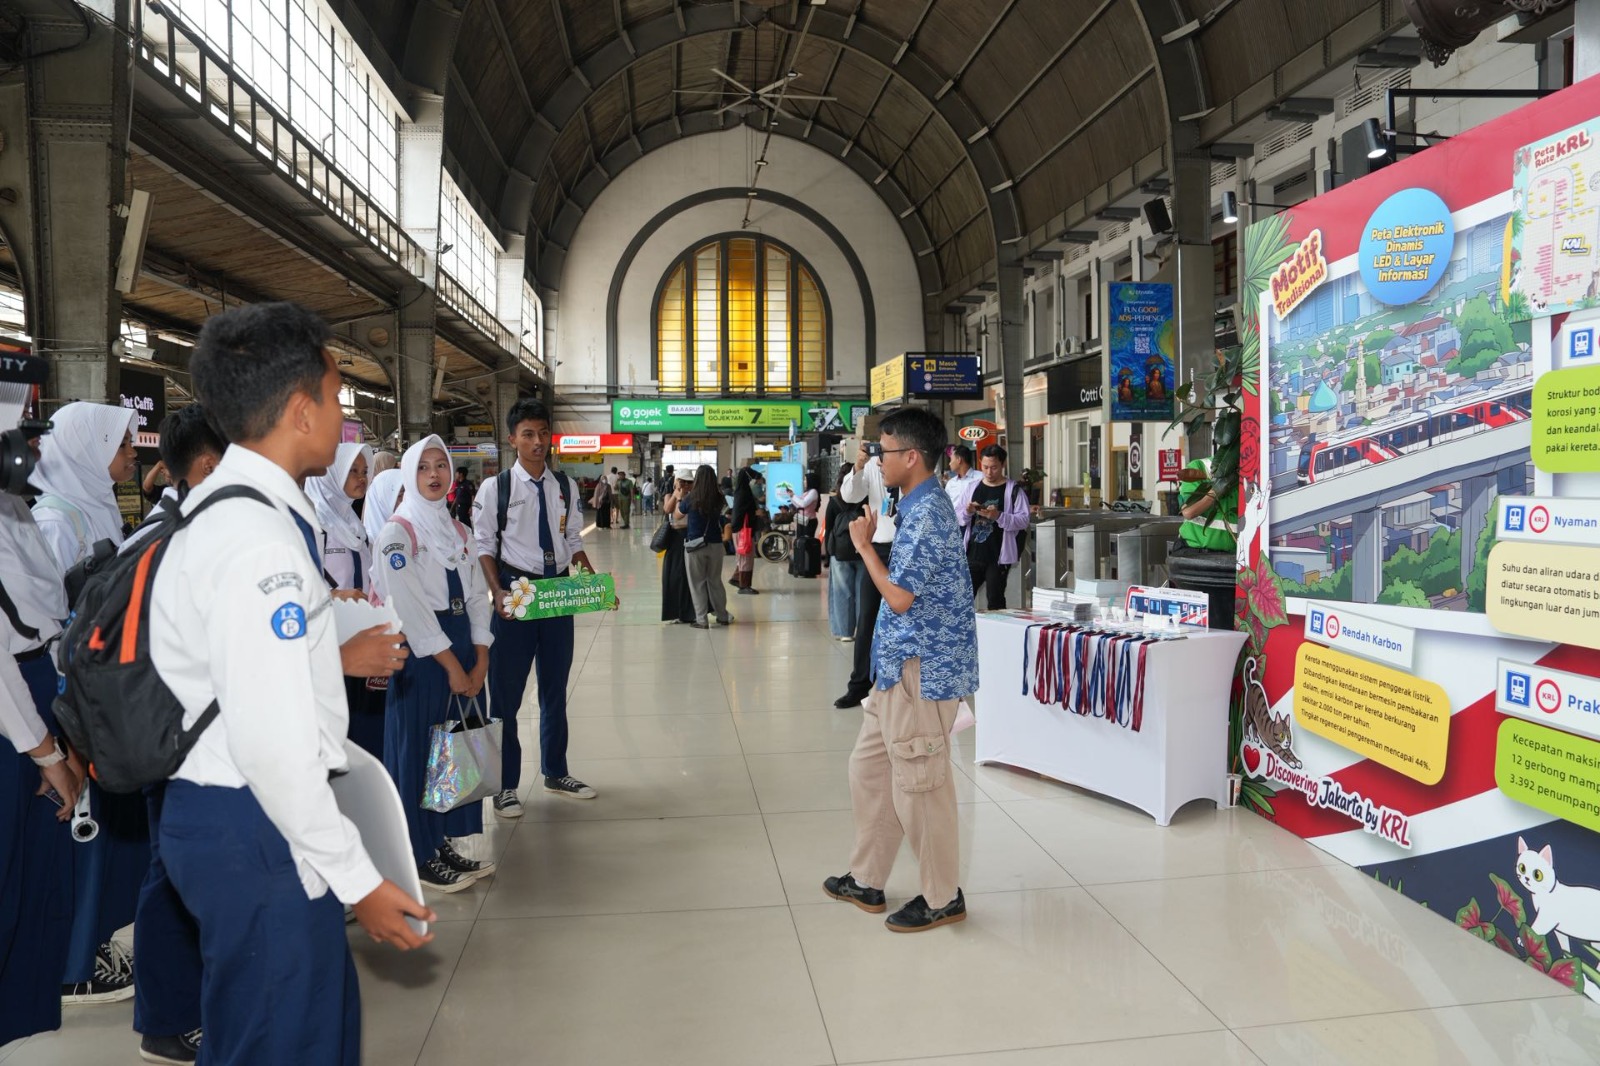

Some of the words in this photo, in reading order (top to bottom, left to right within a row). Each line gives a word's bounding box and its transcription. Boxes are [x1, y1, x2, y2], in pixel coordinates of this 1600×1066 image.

[1534, 145, 1555, 160] Peta
[1535, 154, 1555, 168] Rute
[1371, 227, 1392, 241] Peta
[1394, 222, 1445, 238] Elektronik
[1385, 239, 1424, 253] Dinamis
[1562, 237, 1582, 250] KAI
[1272, 234, 1319, 301] Motif
[1373, 255, 1392, 268] LED
[1394, 254, 1401, 267] &
[1403, 253, 1435, 270] Layar
[1378, 267, 1429, 283] Informasi
[1276, 263, 1325, 315] Tradisional
[1080, 387, 1098, 403] Cotti
[1547, 389, 1581, 400] Struktur
[633, 406, 662, 419] gojek
[748, 408, 762, 424] 7
[1547, 407, 1572, 417] korosi
[1574, 407, 1596, 416] yang
[1546, 426, 1562, 435] dan
[1564, 423, 1600, 434] keandal
[1546, 443, 1569, 454] pakai
[1554, 516, 1598, 528] Nyaman
[1502, 563, 1521, 573] Suhu
[1522, 565, 1538, 575] dan
[1539, 566, 1563, 578] aliran
[1565, 569, 1591, 581] udara
[538, 589, 567, 600] Setiap
[568, 584, 606, 597] Langkah
[1501, 580, 1524, 590] diatur
[1525, 584, 1552, 594] secara
[1553, 586, 1591, 599] otomatis
[539, 596, 601, 610] Berkelanjutan
[1500, 596, 1544, 611] lingkungan
[1546, 602, 1562, 613] luar
[1564, 605, 1580, 616] dan
[280, 607, 299, 620] IX
[286, 621, 296, 634] E
[1342, 625, 1371, 642] Rendah
[1372, 634, 1402, 652] Karbon
[1304, 654, 1321, 665] Kereta
[1321, 660, 1359, 678] menggunakan
[1359, 673, 1378, 685] sistem
[1379, 680, 1412, 697] penggerak
[1412, 690, 1433, 704] listrik.
[1303, 667, 1338, 685] Dibandingkan
[1339, 680, 1368, 697] kendaraan
[1369, 691, 1396, 707] bermesin
[1397, 702, 1439, 723] pembakaran
[1541, 692, 1556, 702] KRL
[1301, 695, 1319, 707] sekitar
[1318, 701, 1333, 713] 2.000
[1333, 708, 1342, 717] ton
[1343, 713, 1352, 721] per
[1353, 716, 1371, 730] tahun.
[1302, 681, 1320, 694] dalam,
[1320, 688, 1334, 699] emisi
[1334, 693, 1353, 707] karbon
[1354, 702, 1364, 711] per
[1364, 704, 1383, 719] kereta
[1383, 712, 1416, 732] berkurang
[1301, 708, 1319, 720] Tingkat
[1319, 716, 1347, 734] regenerasi
[1347, 729, 1383, 750] pengereman
[1383, 744, 1414, 764] mencapai
[1415, 758, 1431, 771] 44%.
[1512, 733, 1563, 757] Kecepatan
[1511, 753, 1523, 766] 12
[1524, 759, 1566, 782] gerbong
[1265, 752, 1319, 801] Discovering
[1319, 780, 1363, 819] Jakarta
[1365, 801, 1379, 831] by
[1379, 810, 1410, 847] KRL
[1509, 773, 1535, 791] 3.392
[1537, 785, 1600, 816] penumpang
